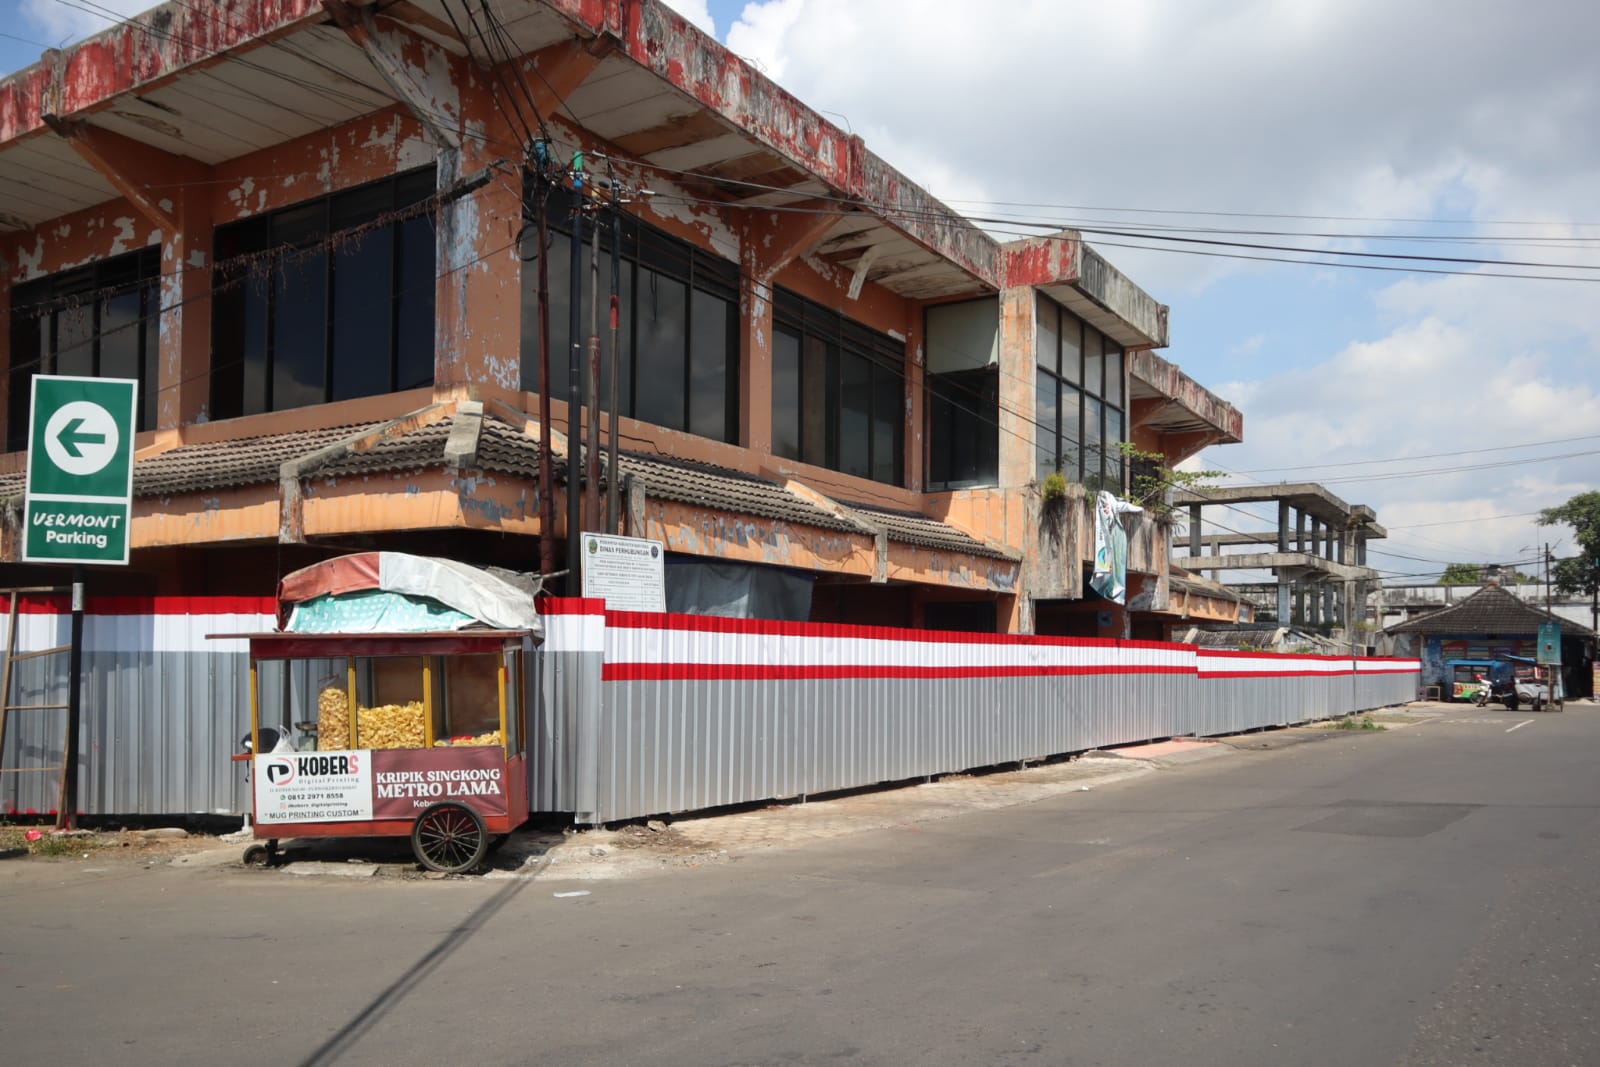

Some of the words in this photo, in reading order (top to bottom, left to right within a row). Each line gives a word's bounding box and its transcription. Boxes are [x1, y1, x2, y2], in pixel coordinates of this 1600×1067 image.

[33, 512, 121, 528] VERMONT
[46, 530, 107, 548] Parking
[376, 771, 424, 784] KRIPIK
[427, 768, 500, 781] SINGKONG
[377, 782, 442, 798] METRO
[446, 780, 500, 796] LAMA
[289, 811, 325, 819] PRINTING
[326, 809, 359, 817] CUSTOM
